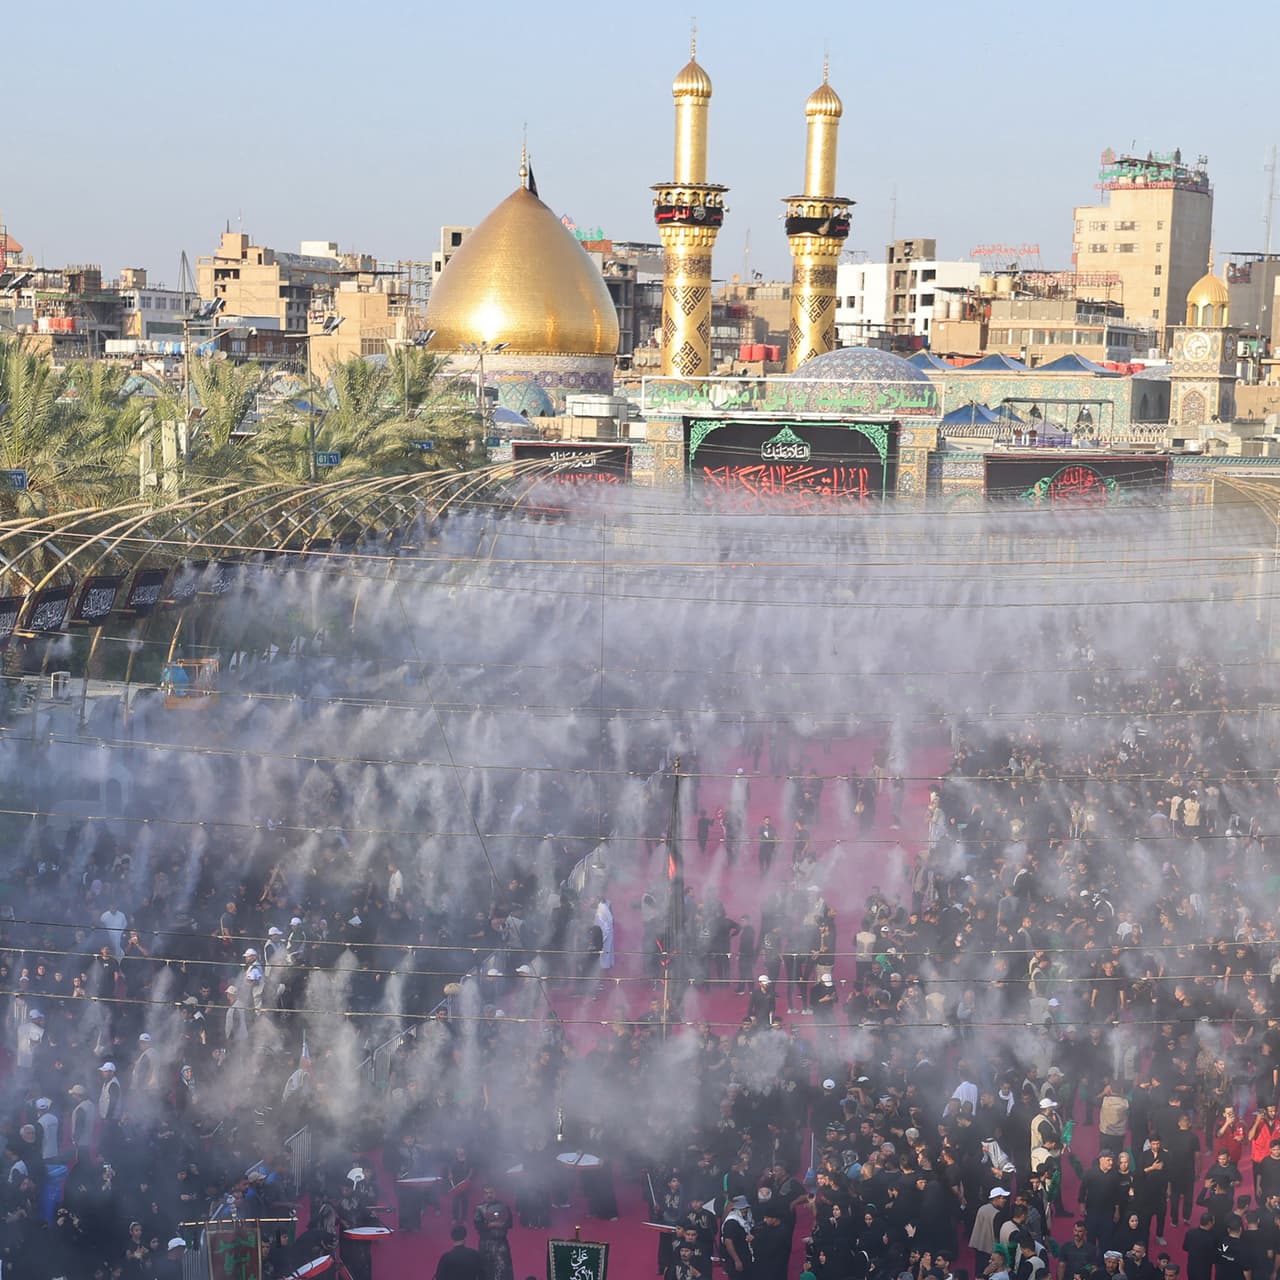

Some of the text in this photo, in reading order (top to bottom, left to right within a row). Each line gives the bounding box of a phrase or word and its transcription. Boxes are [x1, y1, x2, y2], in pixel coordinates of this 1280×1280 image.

[816, 388, 869, 407] عليك
[875, 388, 938, 410] السلام
[763, 443, 809, 460] السلام عليك
[570, 1248, 589, 1271] علي
